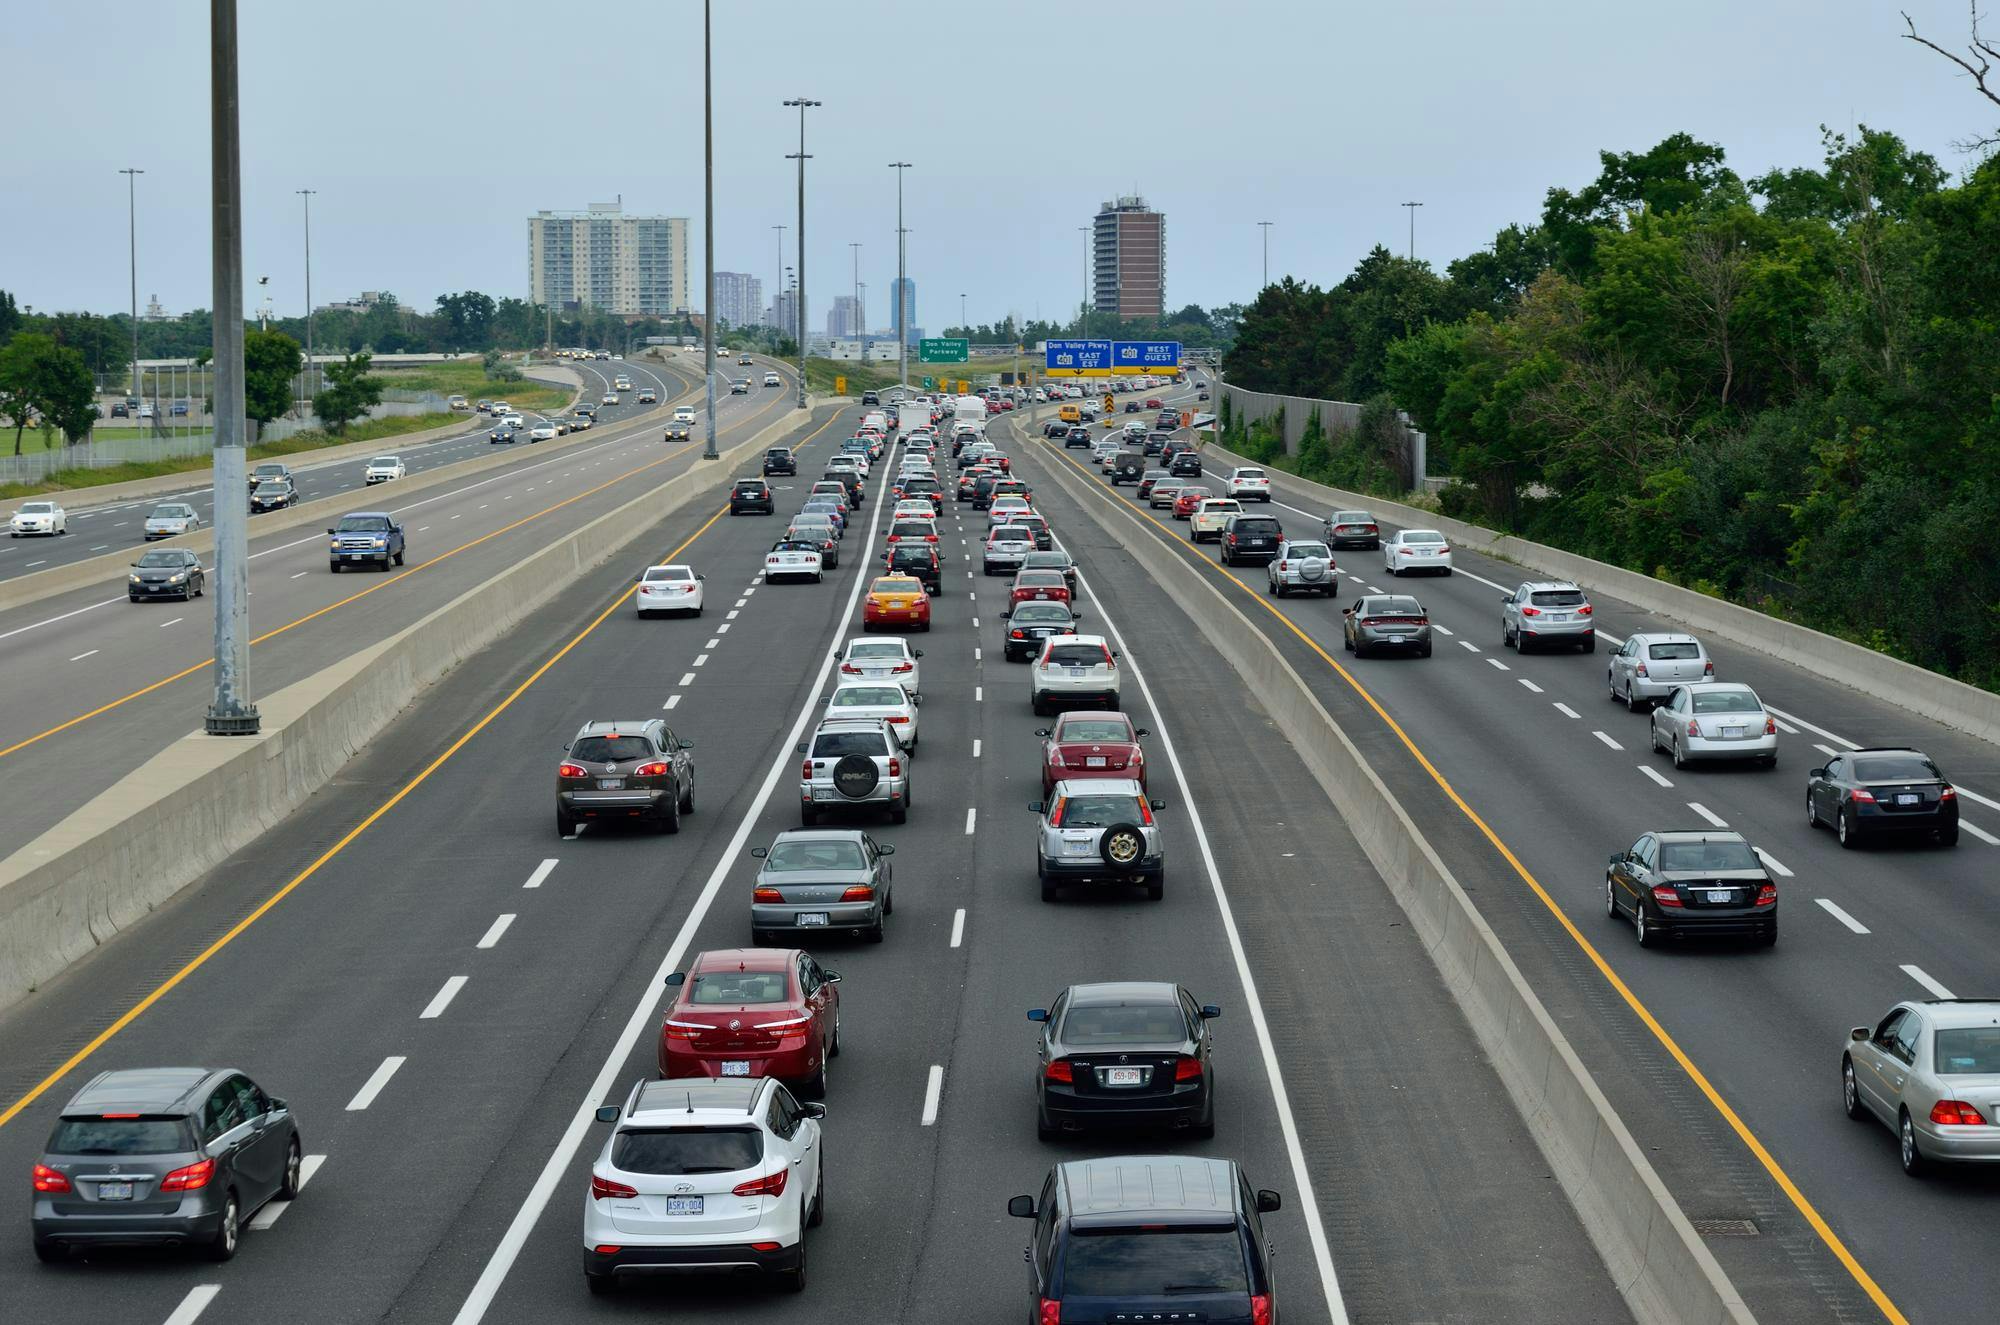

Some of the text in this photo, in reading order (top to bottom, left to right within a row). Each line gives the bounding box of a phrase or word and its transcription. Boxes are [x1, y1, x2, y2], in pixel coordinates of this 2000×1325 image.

[1065, 342, 1086, 350] Valley
[1088, 342, 1109, 350] Pkwy.
[1122, 349, 1137, 358] 401
[1057, 355, 1073, 364] 401
